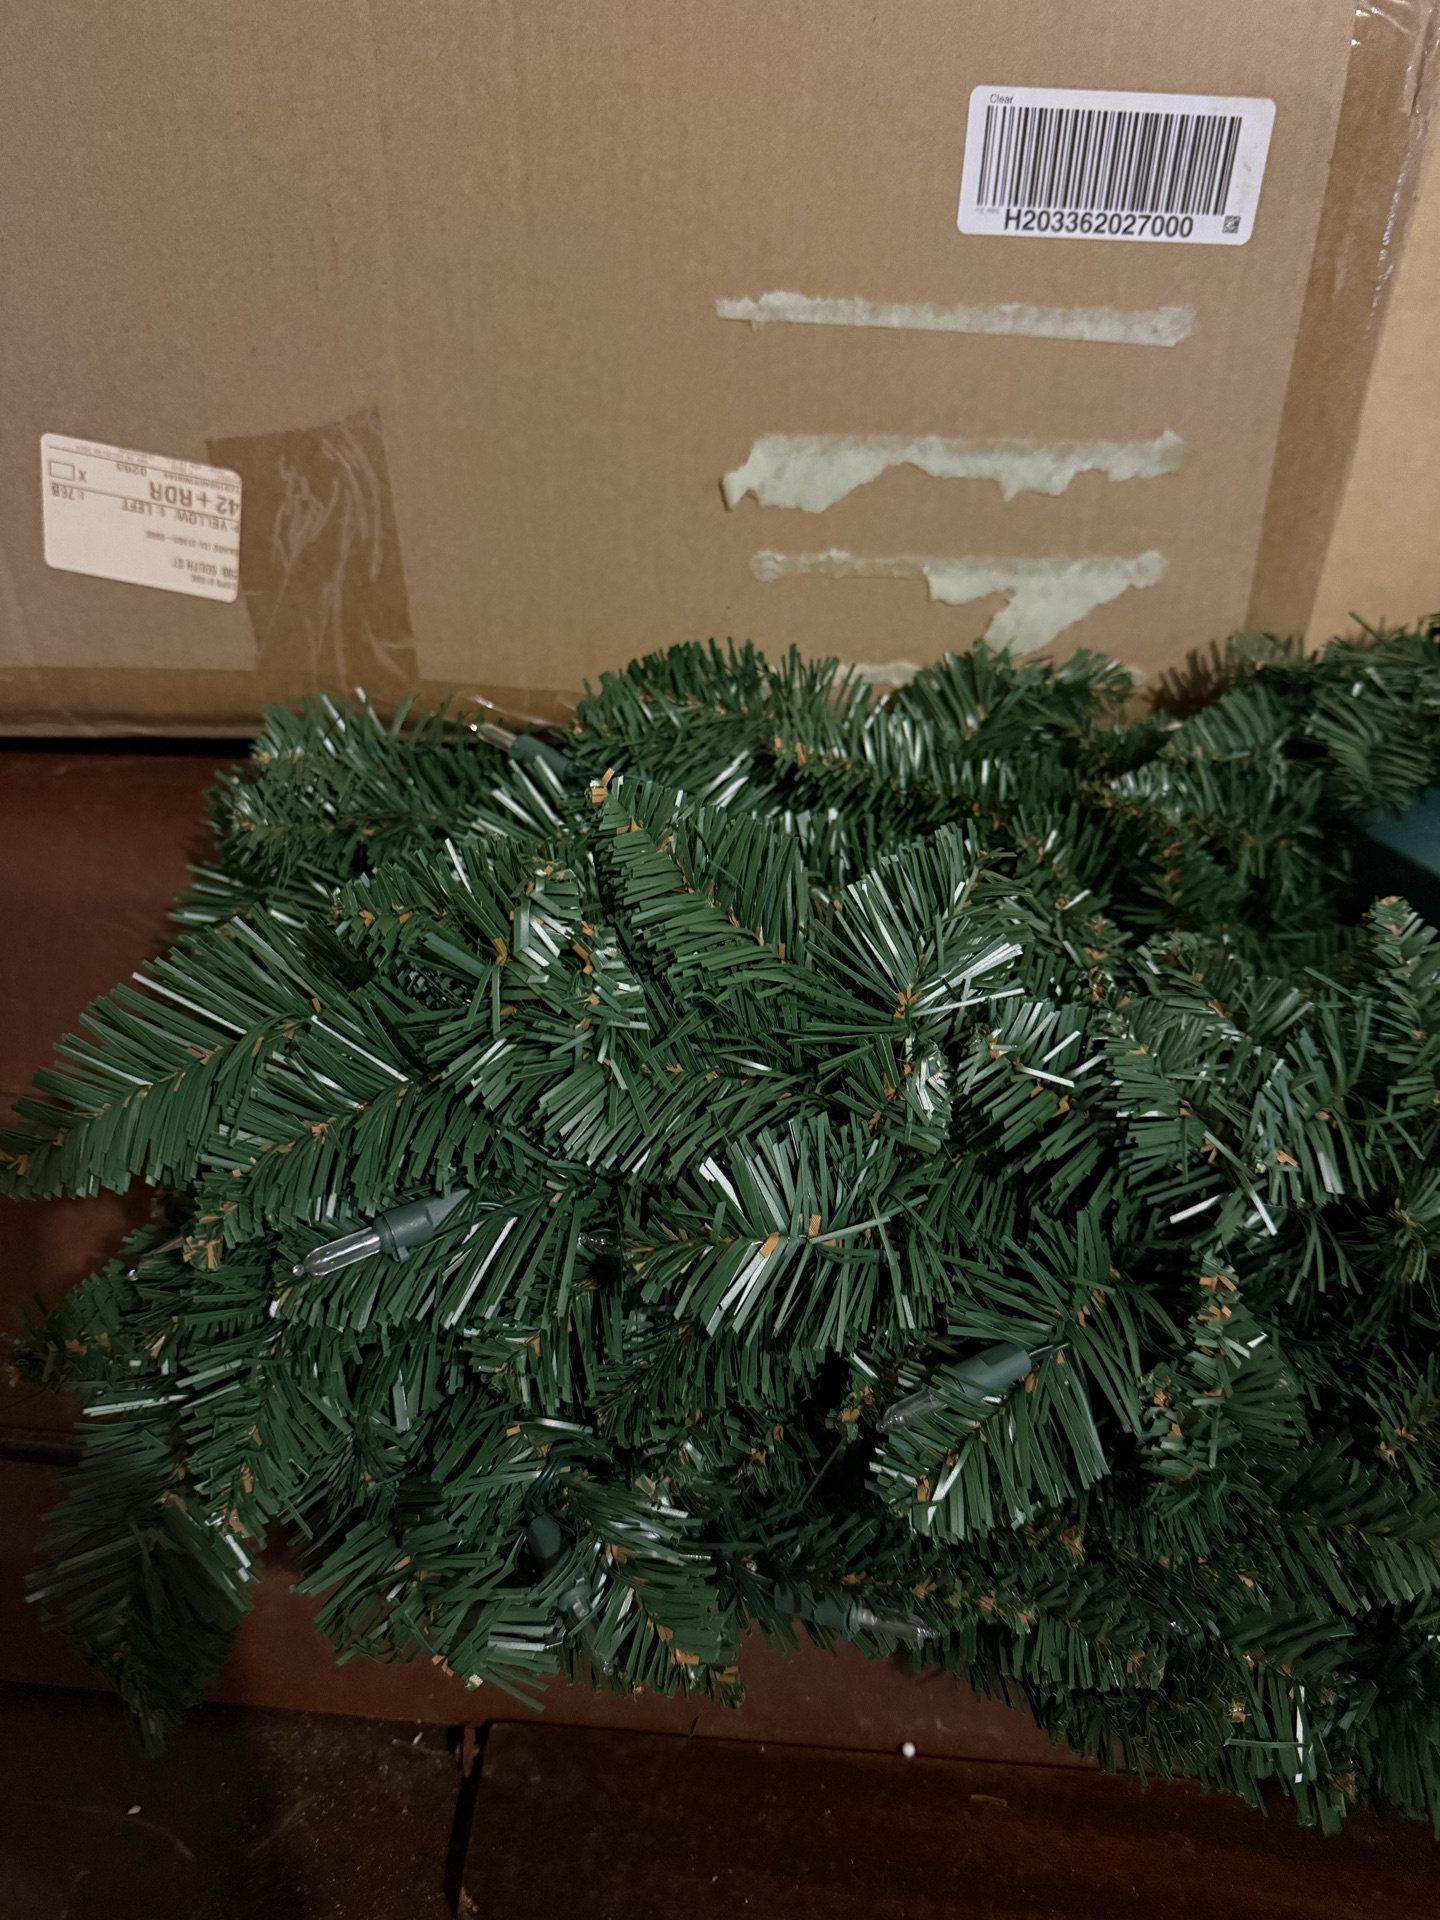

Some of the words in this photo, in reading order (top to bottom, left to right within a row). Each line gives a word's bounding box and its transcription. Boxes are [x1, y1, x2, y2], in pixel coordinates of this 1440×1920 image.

[990, 93, 1014, 105] Clear
[1004, 209, 1194, 237] H203362027000
[121, 499, 152, 516] LEFT
[217, 495, 240, 516] 42
[174, 510, 228, 531] YELLOW
